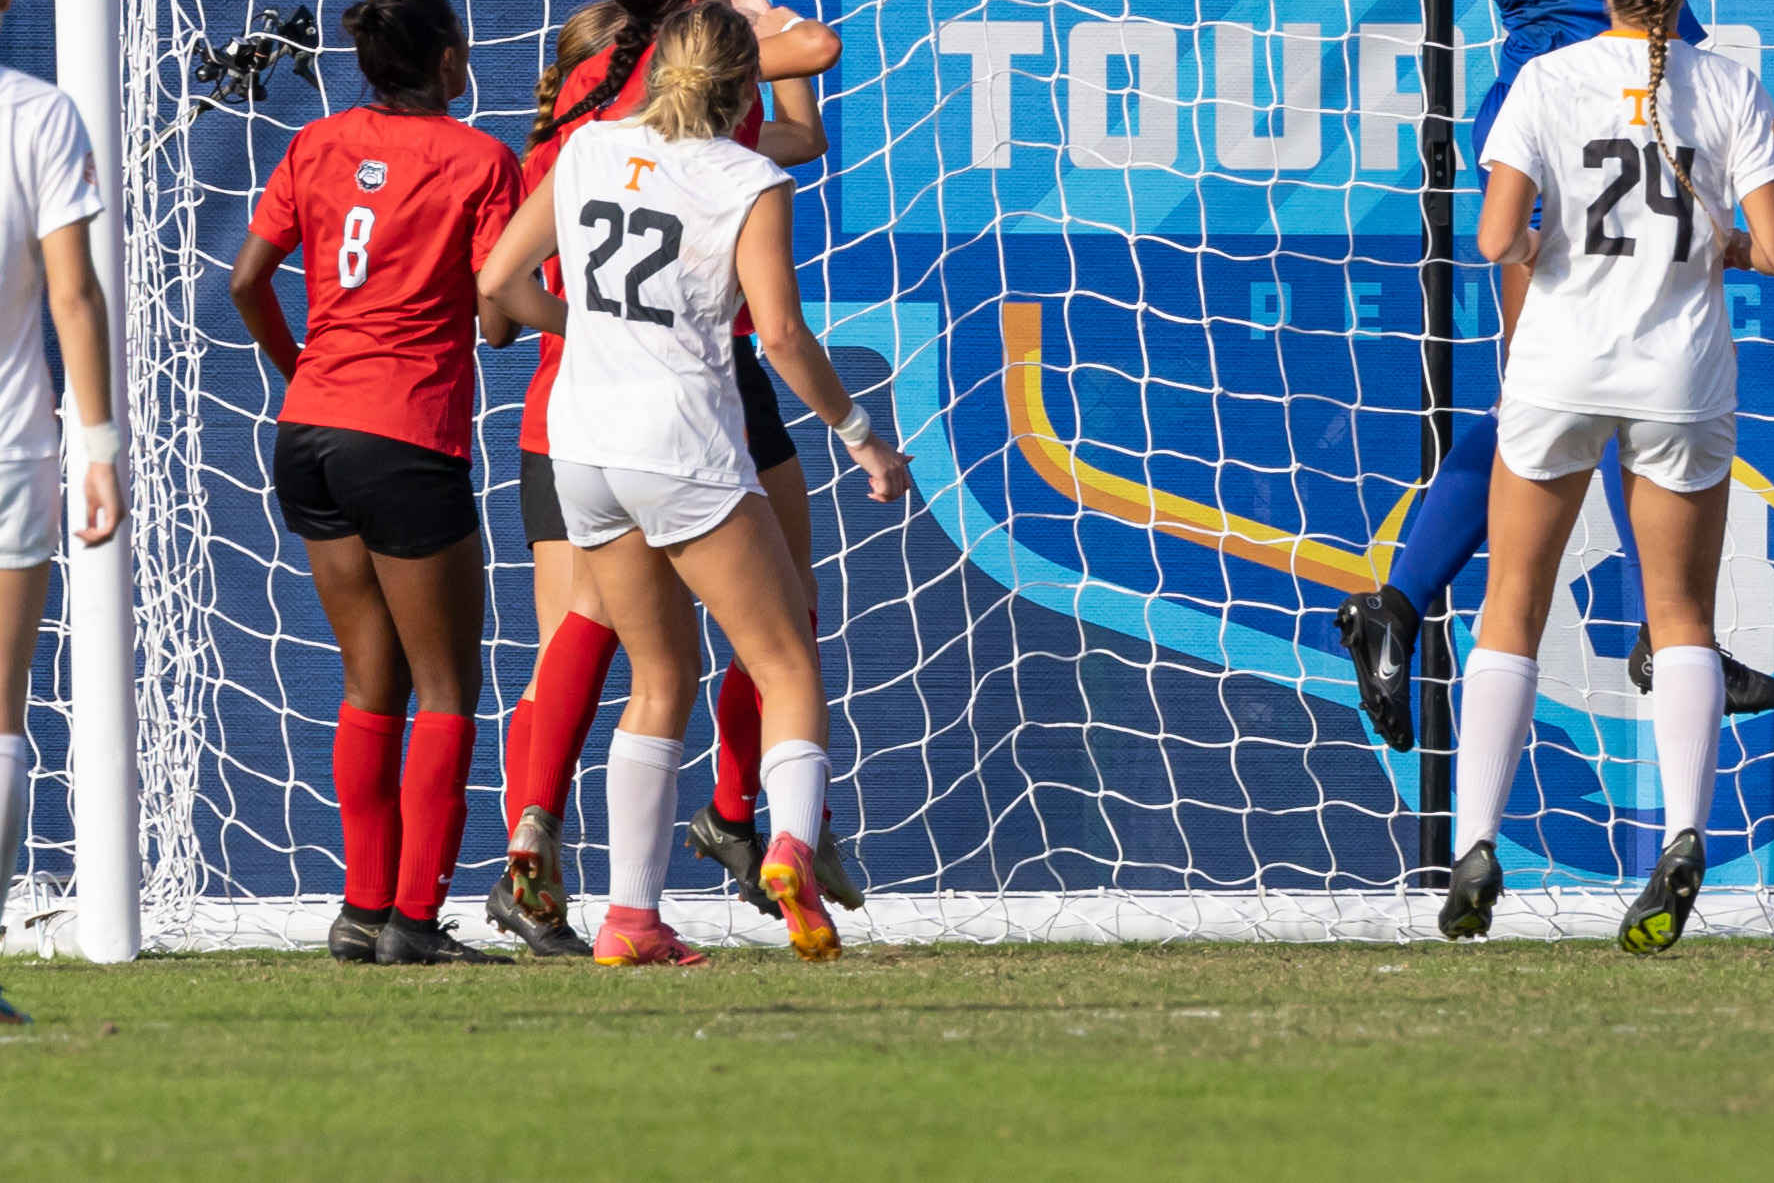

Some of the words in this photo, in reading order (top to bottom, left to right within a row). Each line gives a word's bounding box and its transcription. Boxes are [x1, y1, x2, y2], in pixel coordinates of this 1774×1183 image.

[1622, 88, 1650, 126] T
[624, 156, 657, 192] T
[1582, 138, 1696, 262] 24
[337, 205, 376, 290] 8
[579, 199, 684, 328] 22
